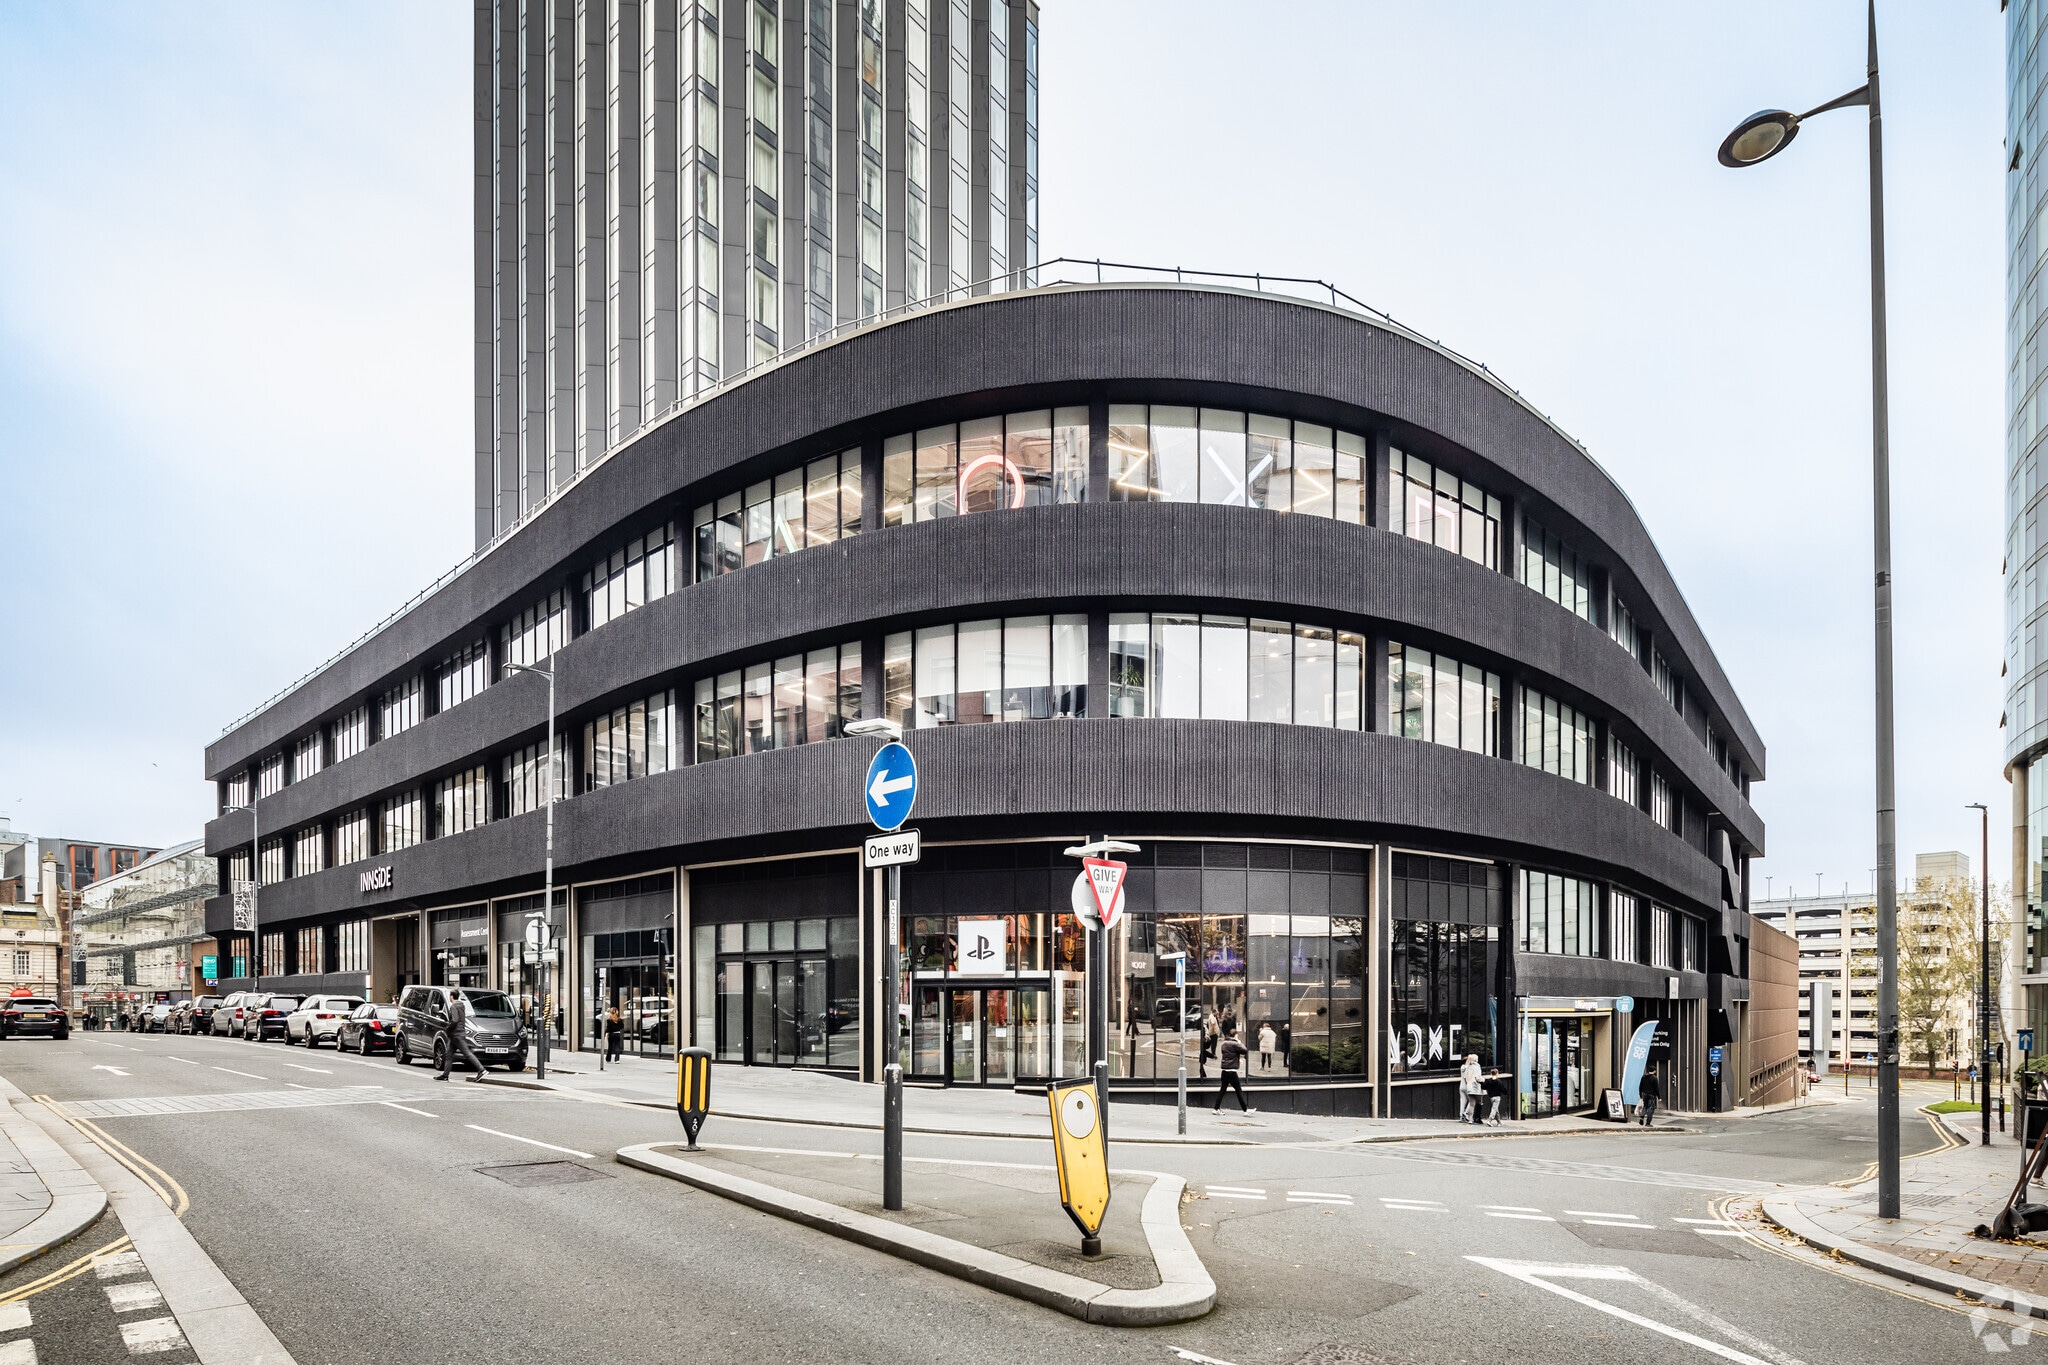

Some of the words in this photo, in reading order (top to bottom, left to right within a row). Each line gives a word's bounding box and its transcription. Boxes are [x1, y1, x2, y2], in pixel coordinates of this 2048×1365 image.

[869, 845, 889, 859] One
[893, 842, 914, 856] way
[1093, 868, 1117, 882] GIVE
[1099, 885, 1114, 894] WAY
